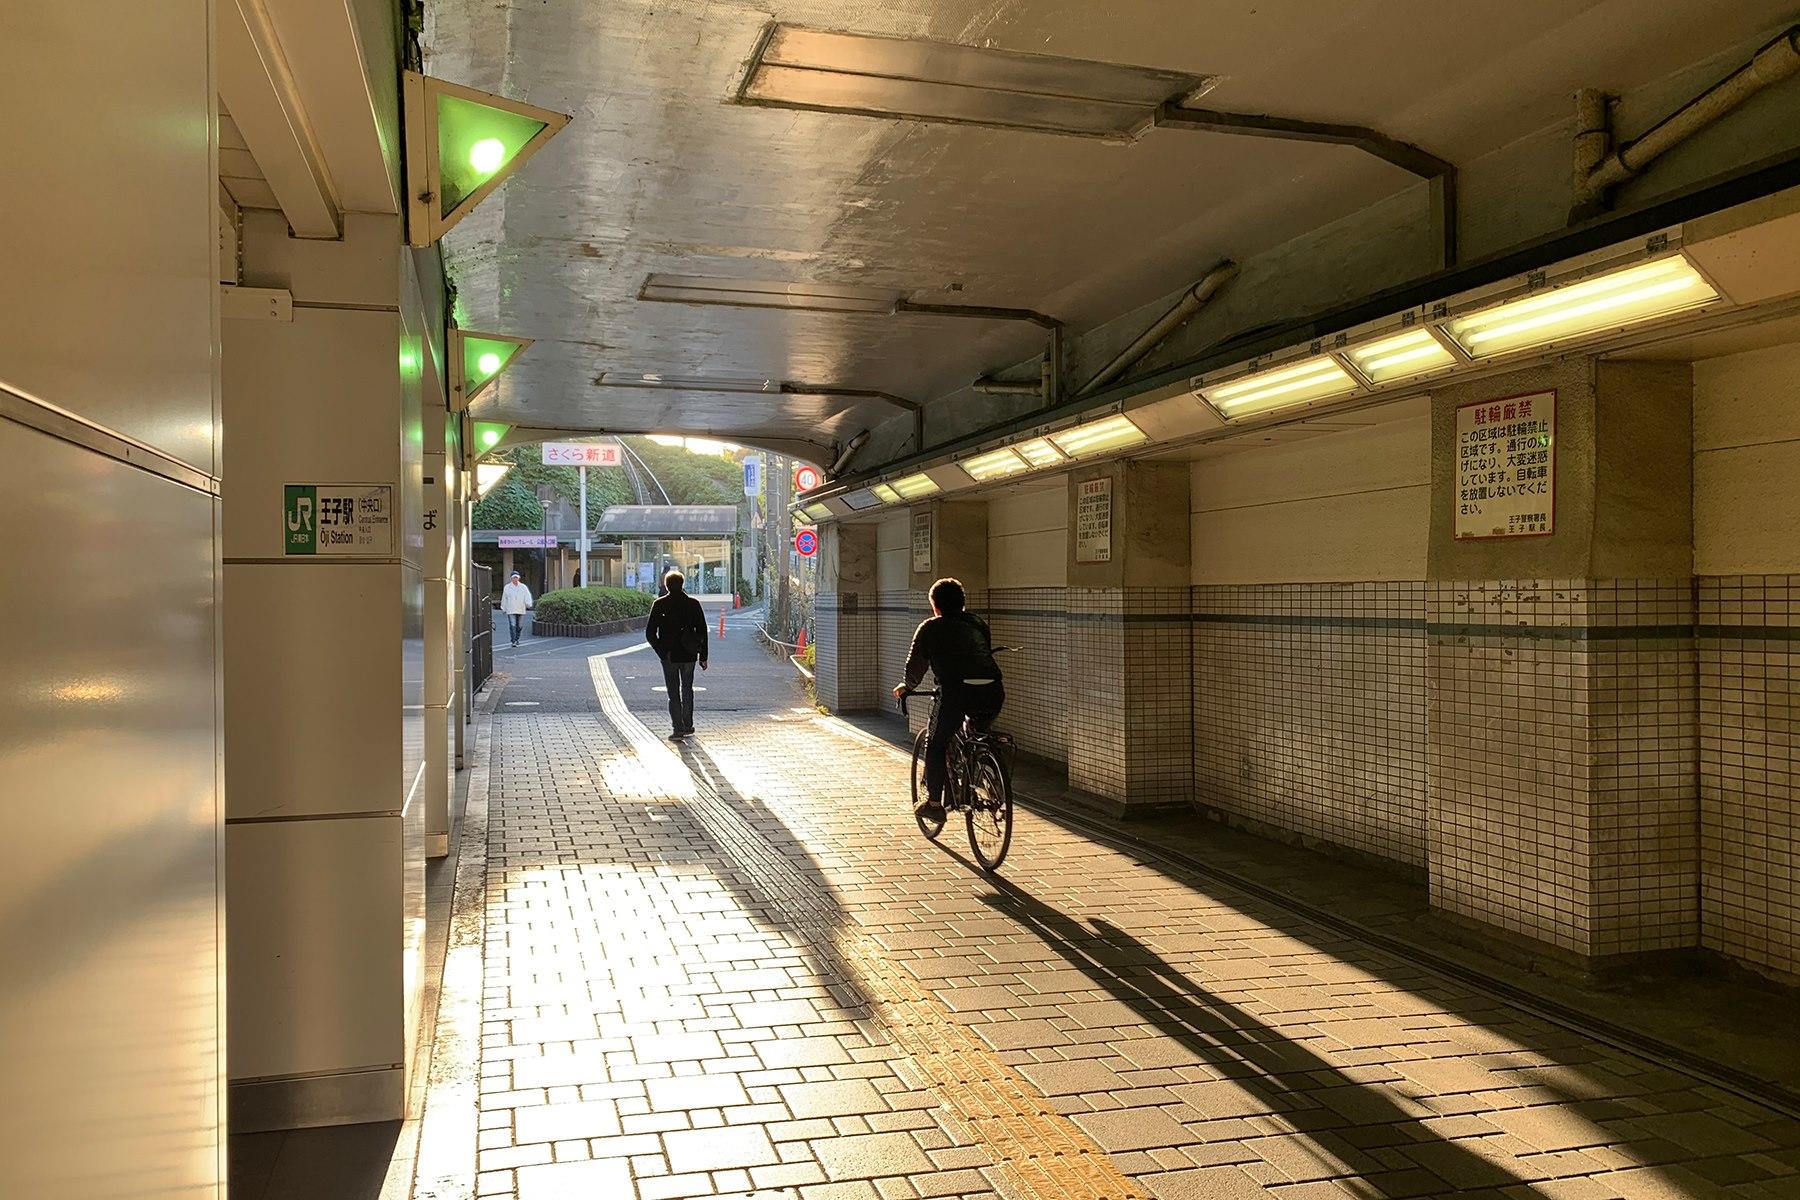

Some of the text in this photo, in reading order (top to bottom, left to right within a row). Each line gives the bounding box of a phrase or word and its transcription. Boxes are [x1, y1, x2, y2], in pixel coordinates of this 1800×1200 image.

[1474, 400, 1533, 426] 駐輪厳禁
[1461, 419, 1548, 444] この区域は駐輪禁止
[548, 447, 616, 462] さくら新道
[1460, 450, 1548, 473] げになり、大変迷惑
[801, 473, 813, 486] 40
[1460, 465, 1548, 487] しています。自転車
[1460, 481, 1547, 501] を放置しないでくだ
[288, 497, 312, 532] JR
[320, 498, 354, 525] 王子駅
[1460, 503, 1483, 515] さい。
[331, 530, 354, 544] Station
